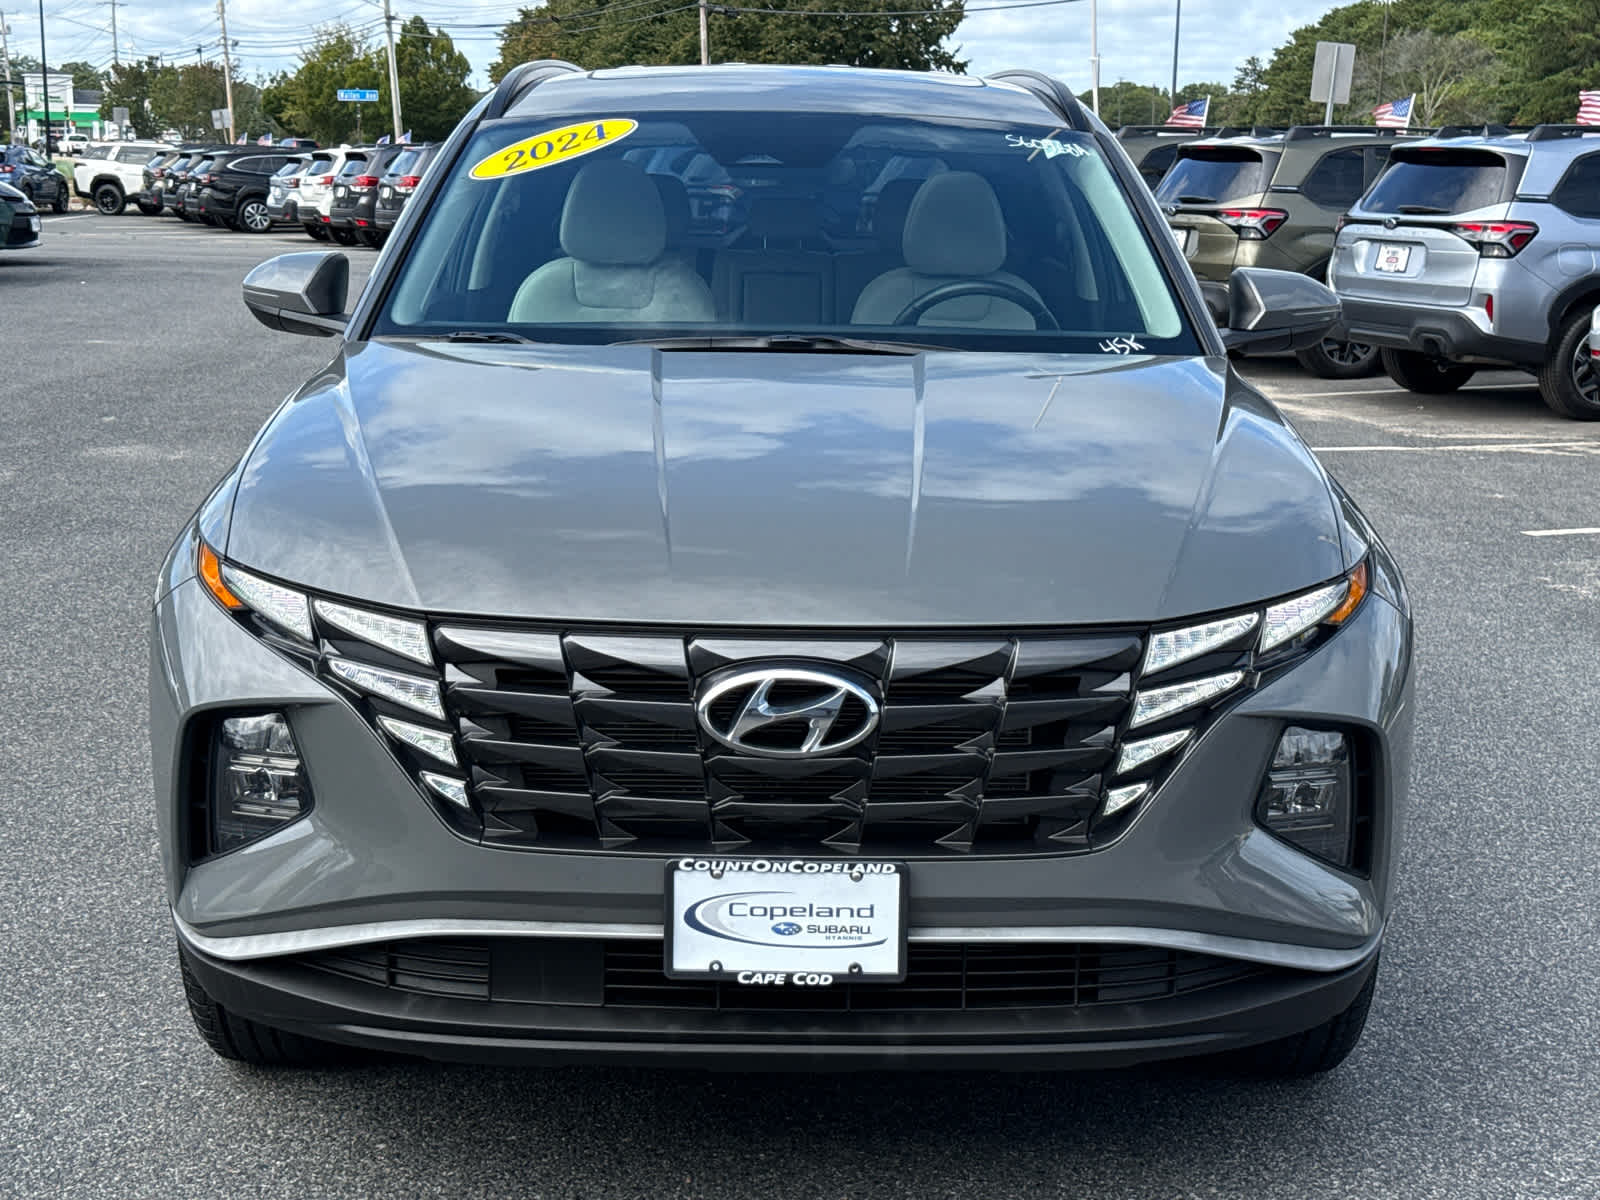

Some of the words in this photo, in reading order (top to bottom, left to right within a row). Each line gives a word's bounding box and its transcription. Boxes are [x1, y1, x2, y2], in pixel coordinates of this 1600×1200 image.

[503, 123, 611, 172] 2024
[1098, 334, 1145, 355] 45K
[728, 902, 875, 920] Copeland
[807, 924, 870, 935] SUBARU
